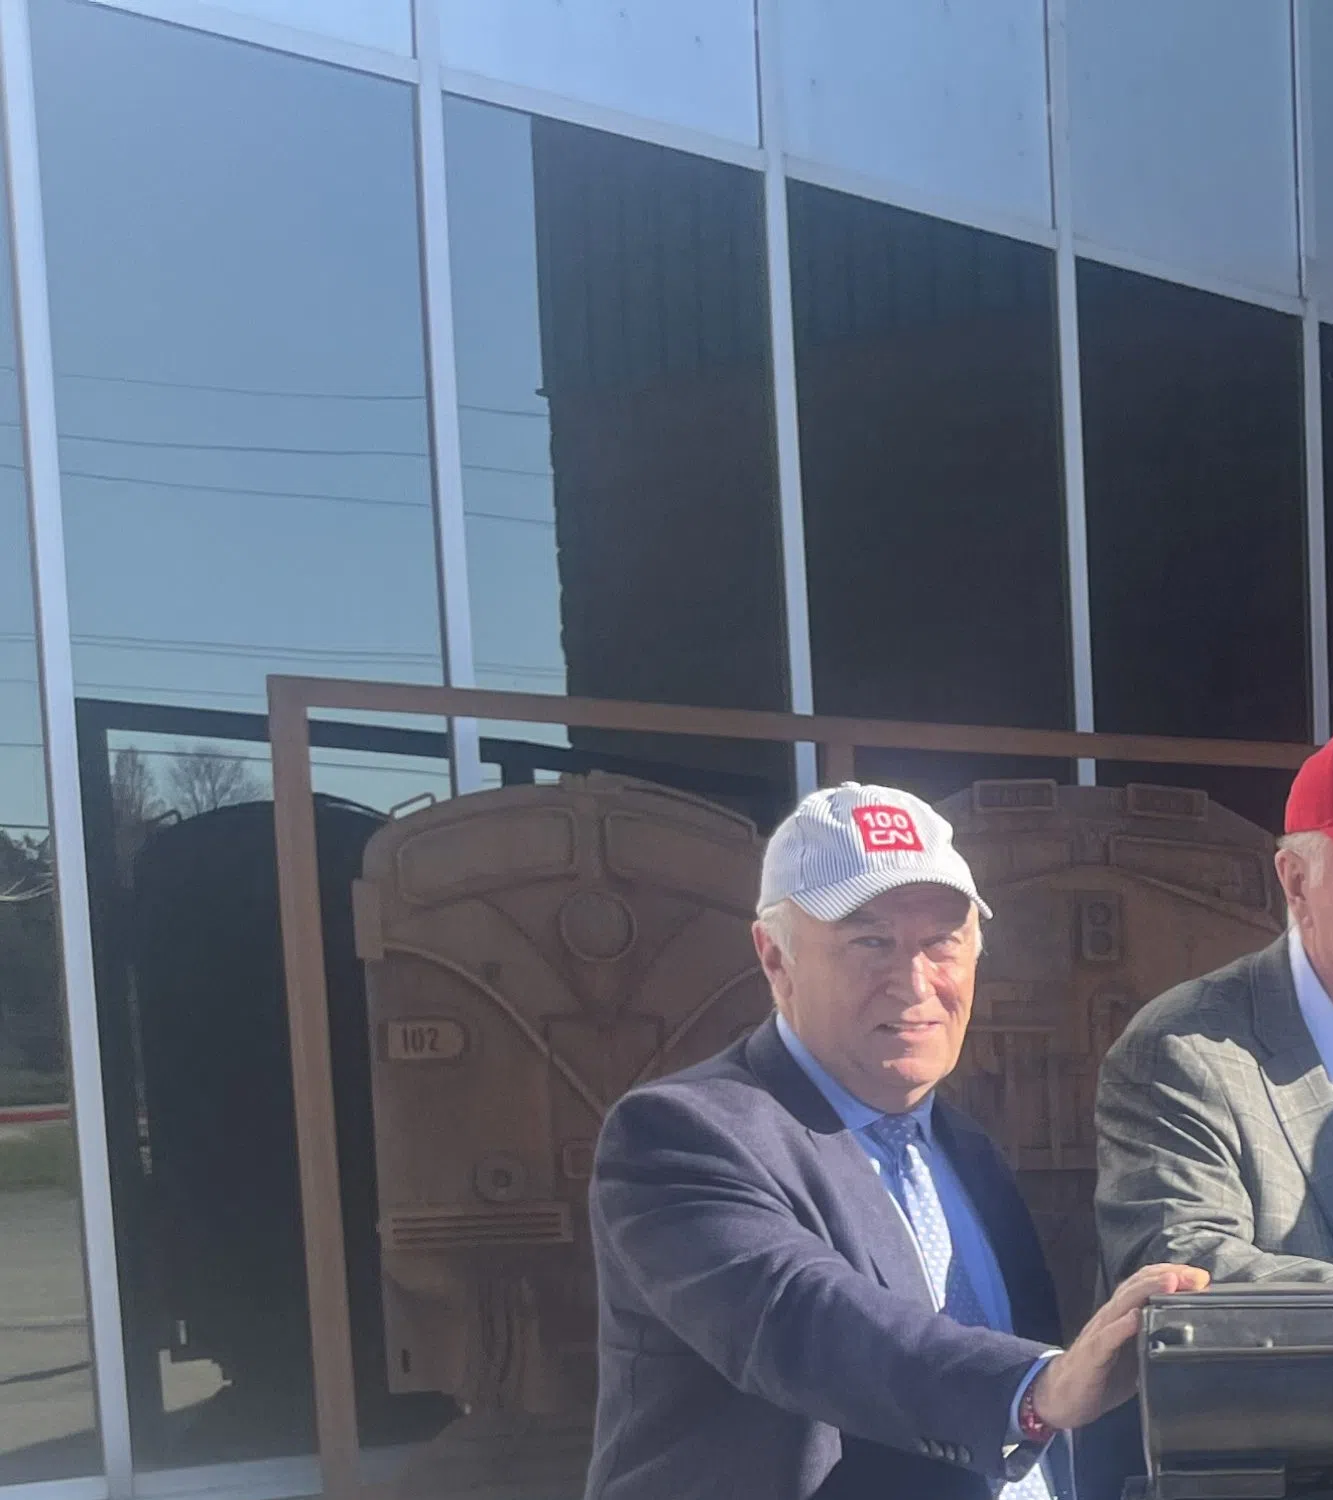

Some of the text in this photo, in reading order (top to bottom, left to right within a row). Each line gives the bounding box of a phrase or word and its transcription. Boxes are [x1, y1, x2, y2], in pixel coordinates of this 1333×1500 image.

[862, 811, 909, 829] 100
[869, 830, 915, 845] CN
[401, 1027, 440, 1053] 102
